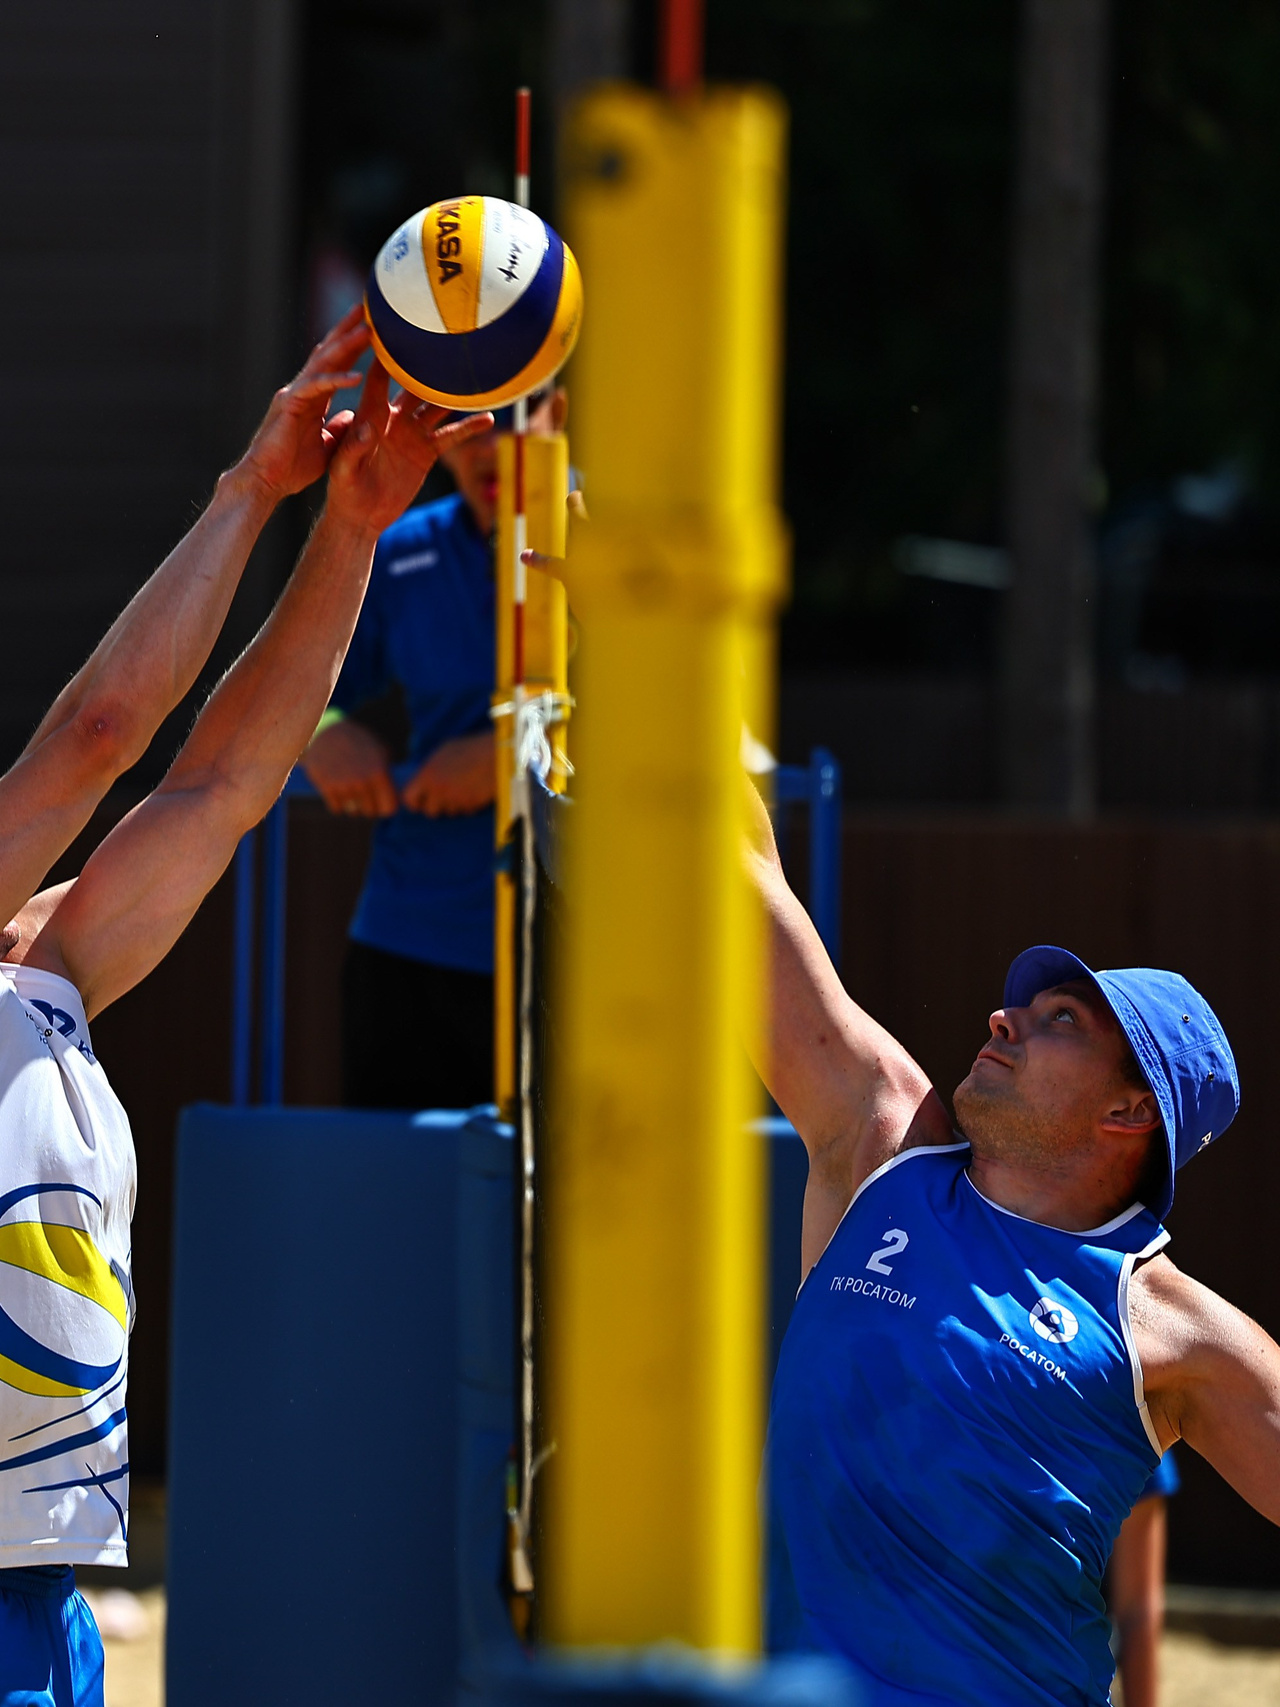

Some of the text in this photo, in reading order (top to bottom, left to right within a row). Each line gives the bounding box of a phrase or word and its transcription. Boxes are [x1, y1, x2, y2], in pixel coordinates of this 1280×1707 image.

[865, 1228, 909, 1276] 2
[830, 1276, 917, 1309] ГК РОСАТОМ
[999, 1333, 1066, 1381] РОСАТОМ
